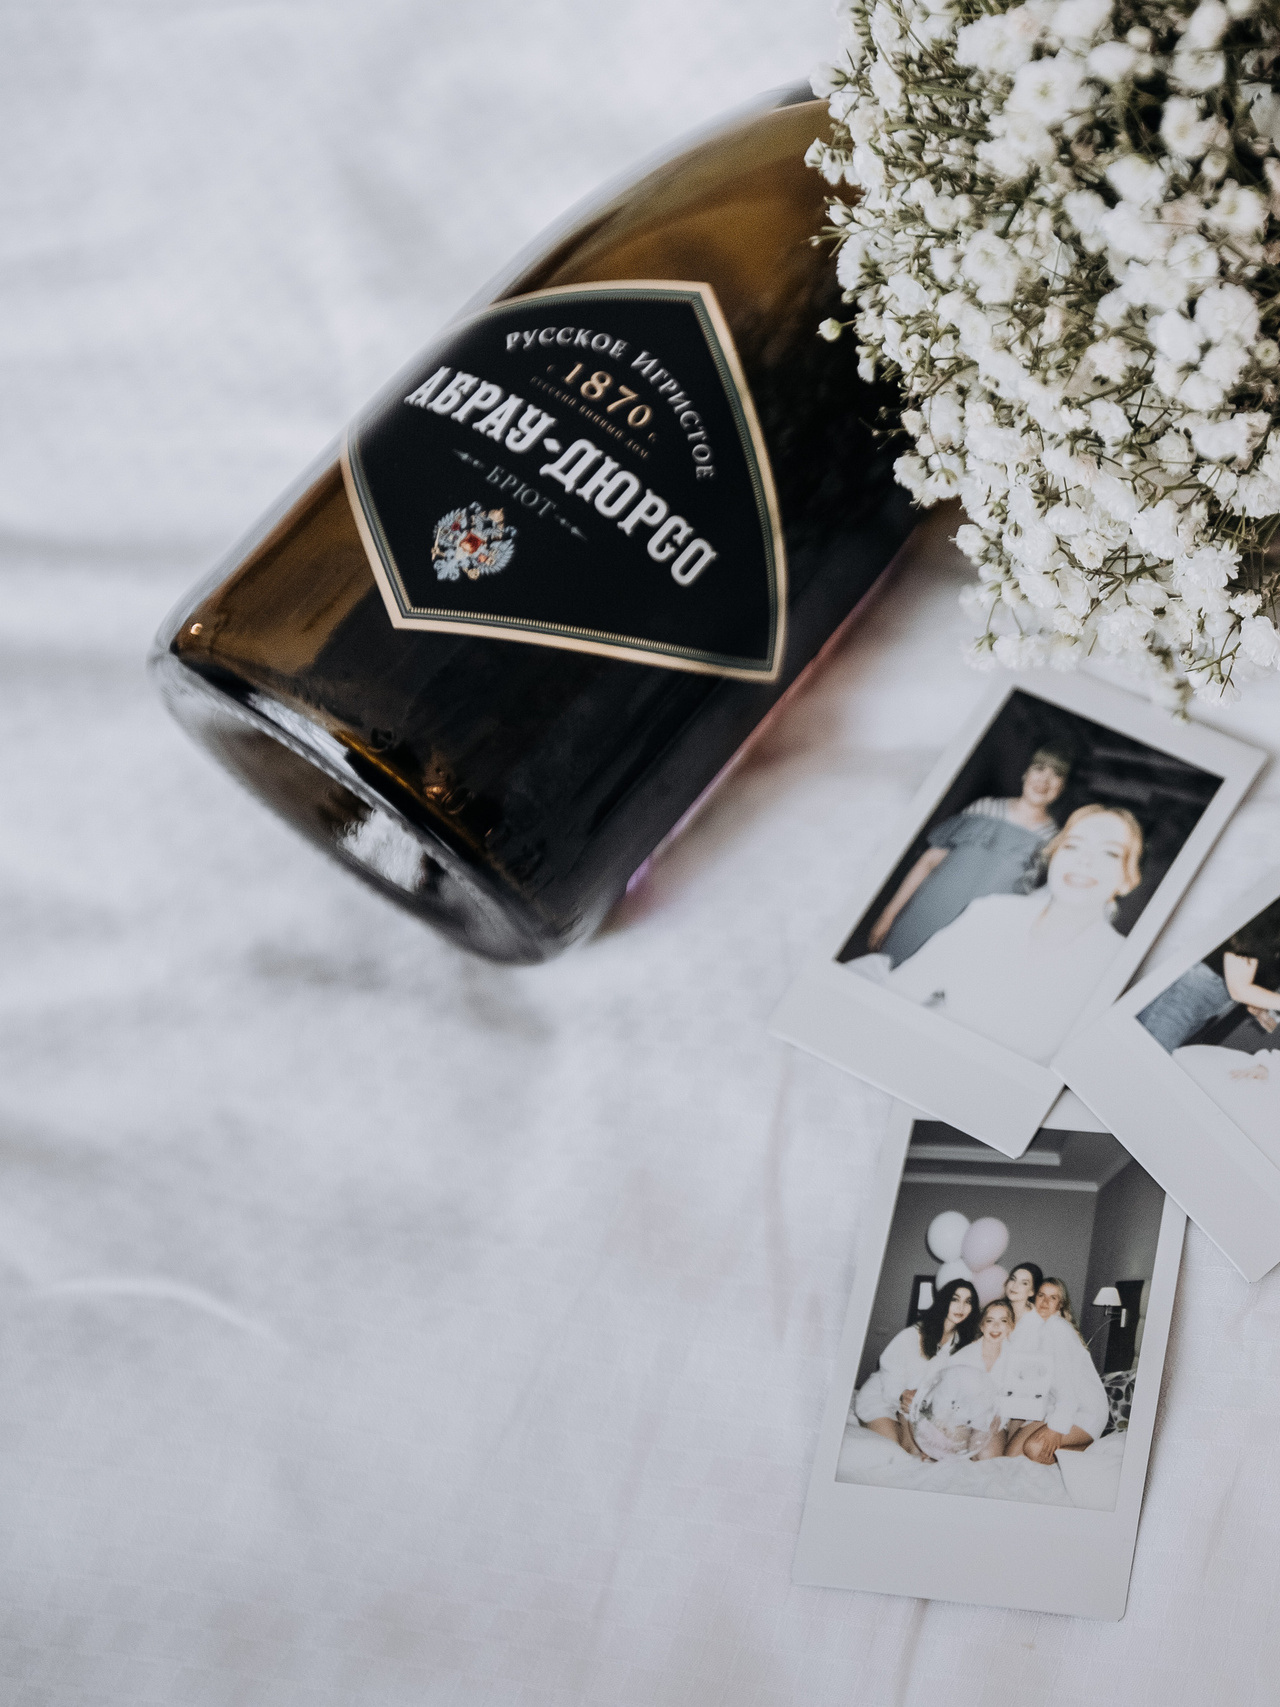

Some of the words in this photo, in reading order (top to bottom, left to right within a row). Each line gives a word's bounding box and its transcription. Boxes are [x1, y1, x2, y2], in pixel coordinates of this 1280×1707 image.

[505, 326, 629, 360] РУССКОЕ
[631, 350, 716, 481] ИГРИСТОЕ
[562, 361, 653, 428] 1870
[403, 365, 719, 587] АБРАУ-ДЮРСО
[485, 465, 557, 517] БРЮТ
